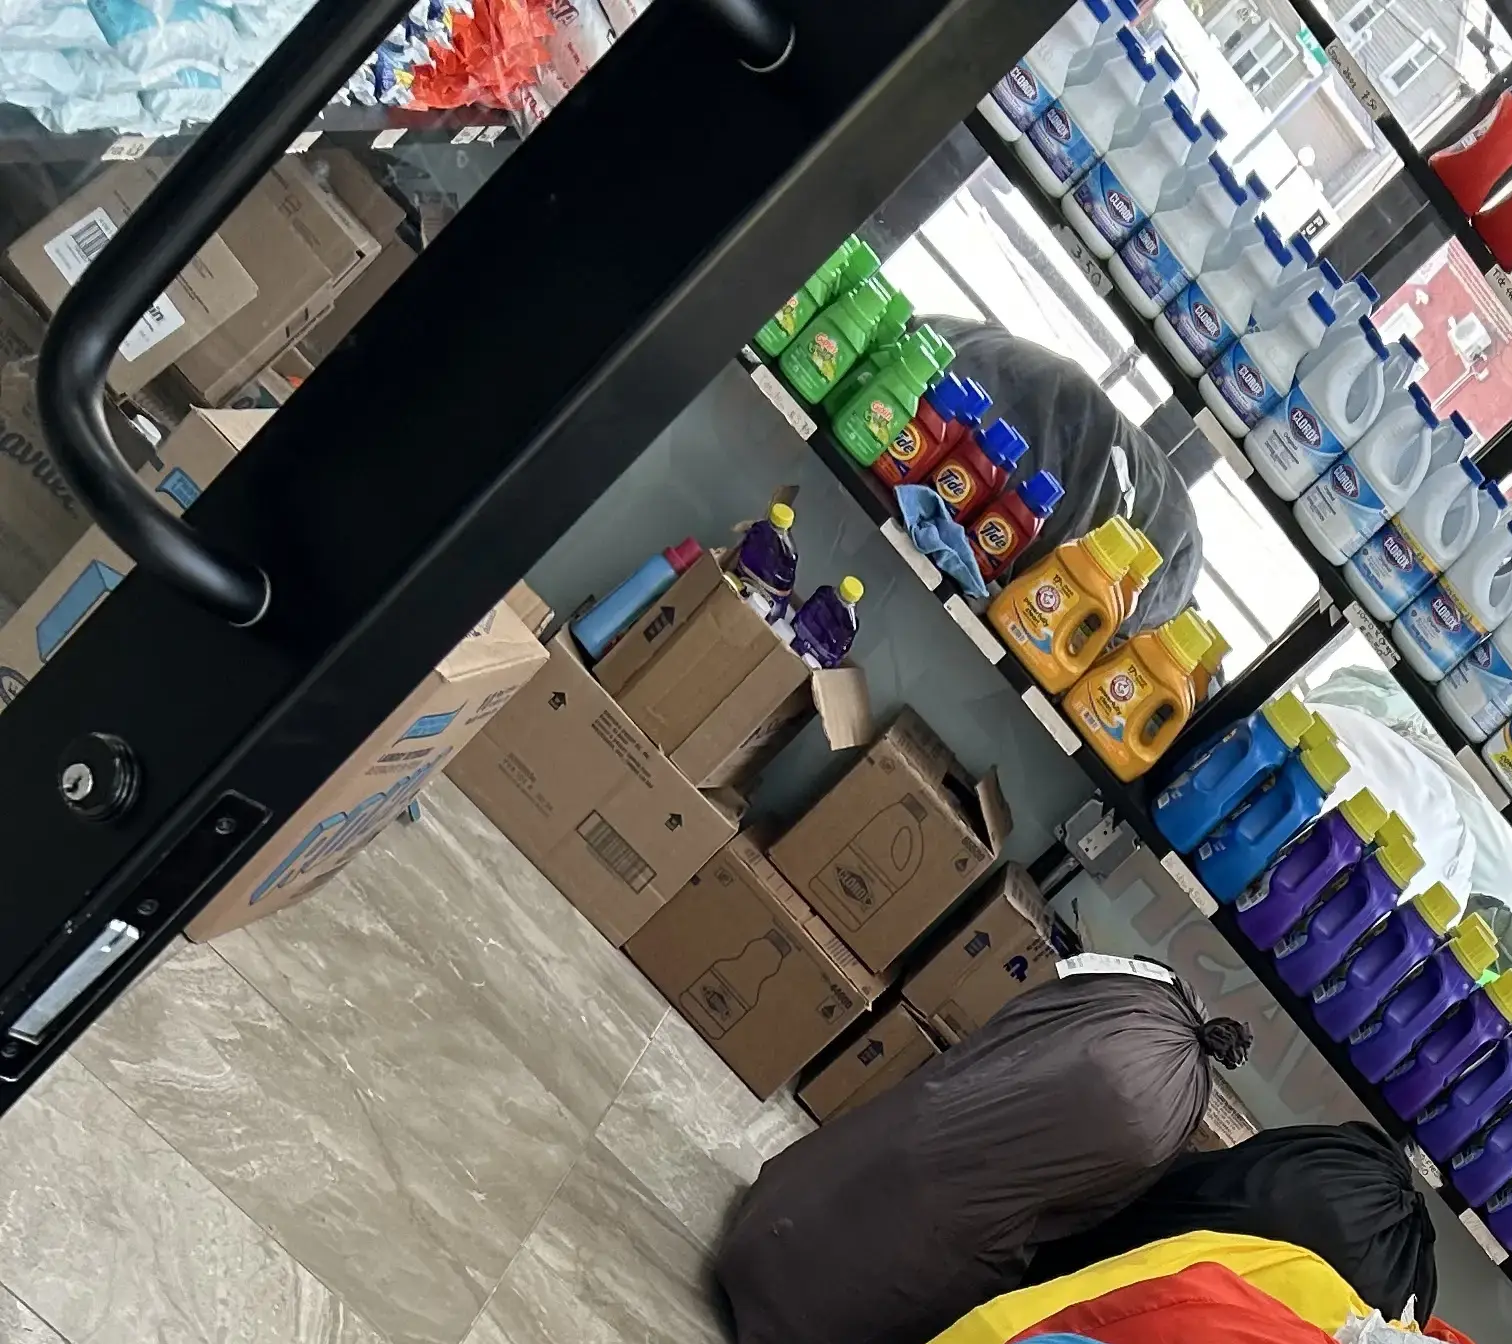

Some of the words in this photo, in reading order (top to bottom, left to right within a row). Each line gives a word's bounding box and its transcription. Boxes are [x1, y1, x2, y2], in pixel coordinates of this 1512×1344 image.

[1006, 65, 1039, 102] CLOROX
[1042, 106, 1073, 139] CLOROX
[1105, 191, 1136, 226] CLOROX
[1133, 226, 1160, 257] CLOROX
[1190, 304, 1221, 339] CLOROX
[1234, 363, 1265, 398] CLOROX
[1289, 409, 1321, 445] CLOROX
[936, 467, 968, 497] Tide
[1332, 464, 1357, 496] CLOROX
[978, 519, 1010, 550] Tide
[1381, 535, 1412, 570] CLOROX
[1430, 597, 1460, 631] CLOROX
